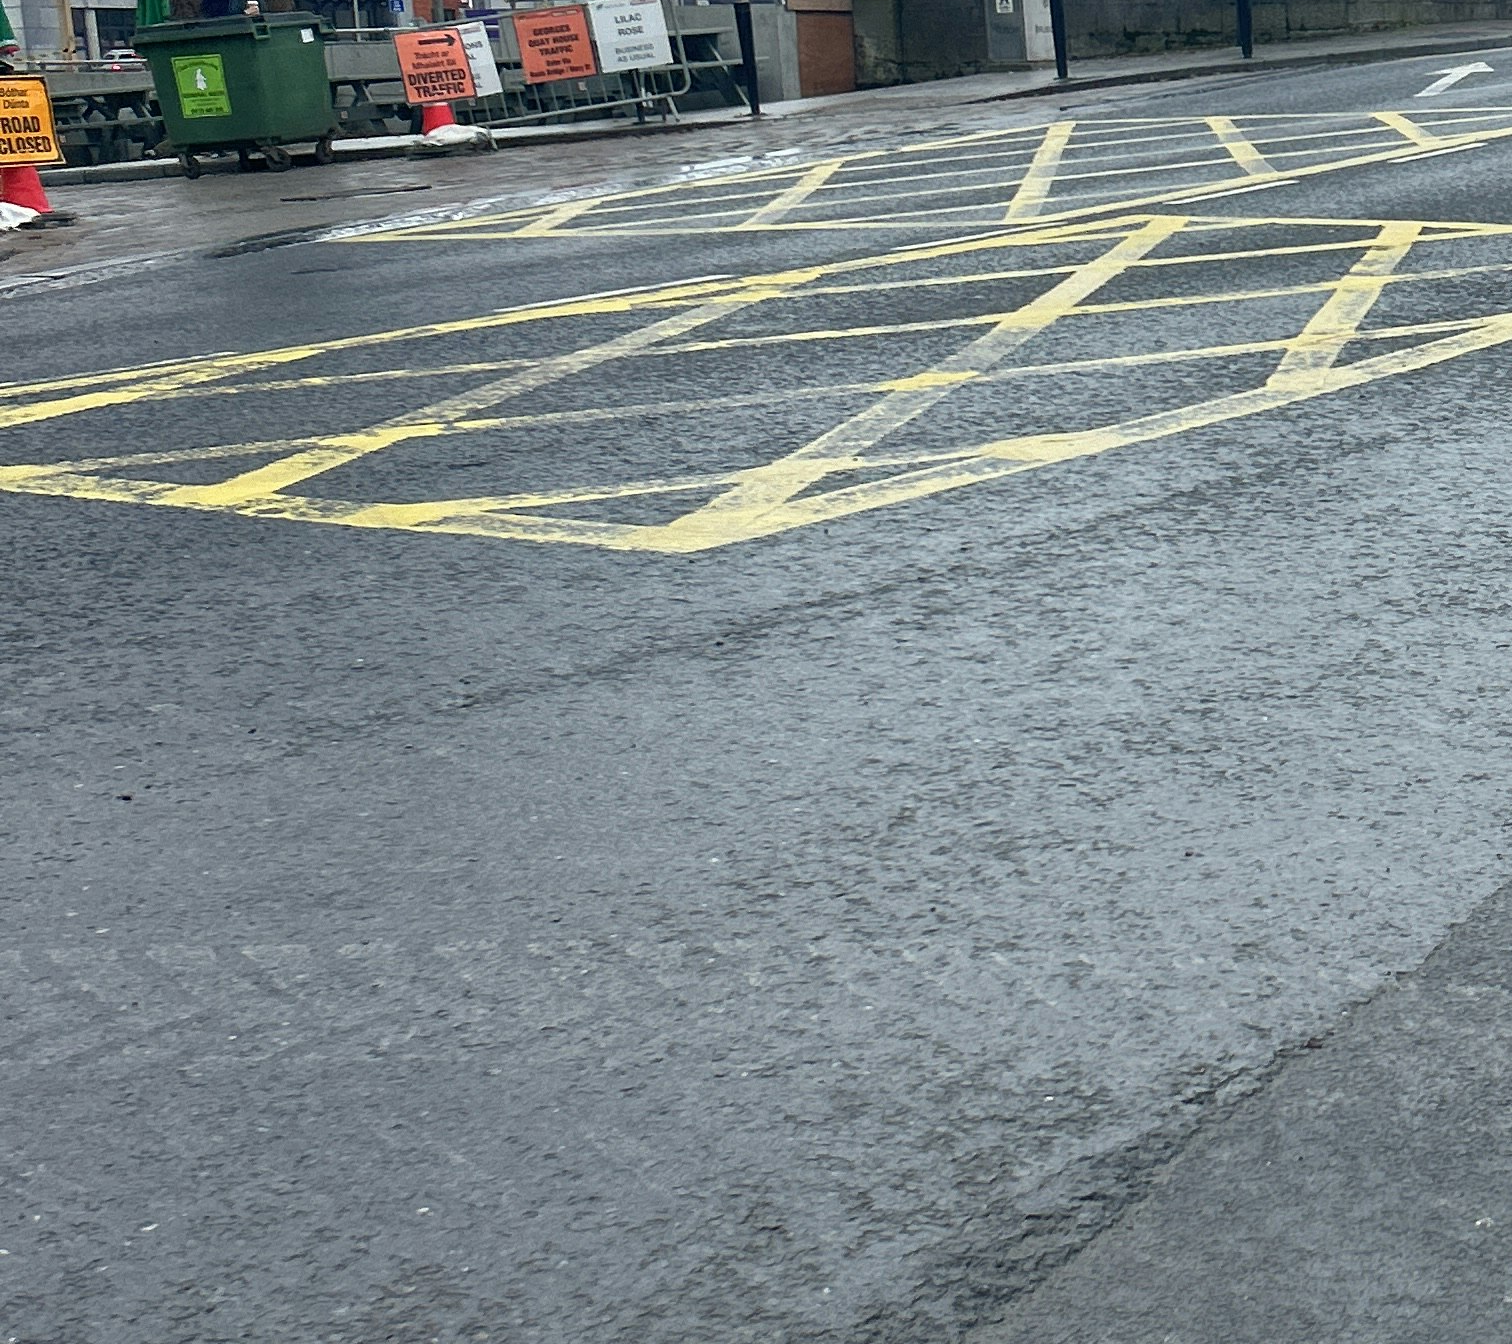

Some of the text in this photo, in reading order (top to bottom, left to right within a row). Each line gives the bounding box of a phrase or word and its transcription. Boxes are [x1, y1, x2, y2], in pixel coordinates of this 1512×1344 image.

[614, 12, 642, 24] LILAC
[617, 25, 644, 36] ROSE
[539, 44, 573, 56] TRAFFIC
[407, 68, 467, 86] DIVERTED
[414, 81, 465, 98] TRAFFIC
[0, 116, 41, 134] ROAD
[0, 136, 52, 155] CLOSED
